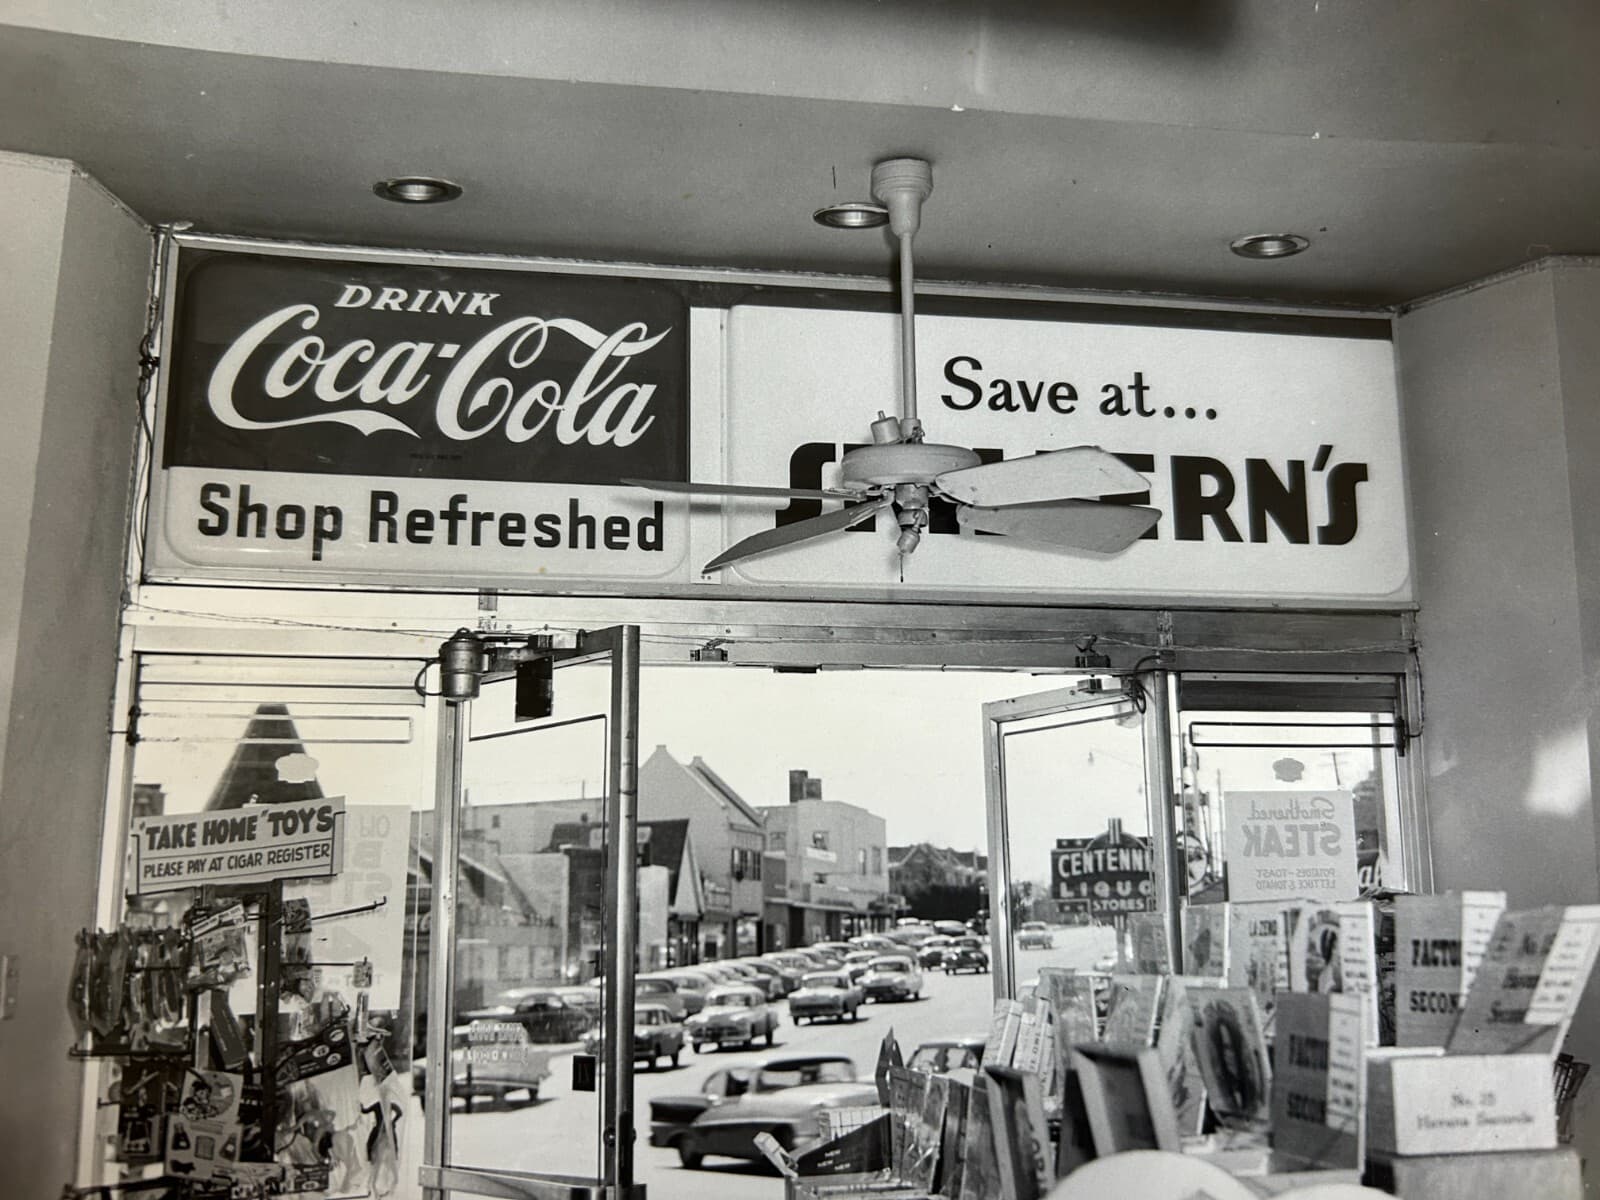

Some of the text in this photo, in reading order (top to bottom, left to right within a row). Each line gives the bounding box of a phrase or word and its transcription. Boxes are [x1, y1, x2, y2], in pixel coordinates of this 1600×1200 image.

[333, 284, 502, 317] DRINK
[206, 303, 673, 448] Coca-Cola
[940, 355, 1079, 416] Save
[775, 441, 1369, 546] SRN'S
[197, 482, 665, 562] Shop Refreshed
[267, 804, 335, 838] TOYS
[143, 860, 184, 879] PLEASE
[187, 858, 207, 875] PAY
[208, 856, 225, 873] AT
[227, 852, 264, 871] CIGAR
[266, 842, 331, 865] REGISTER
[1057, 848, 1151, 878] CENTENNI
[1059, 879, 1152, 898] LIQUO
[1092, 898, 1145, 911] STORES
[1409, 990, 1460, 1015] SECON
